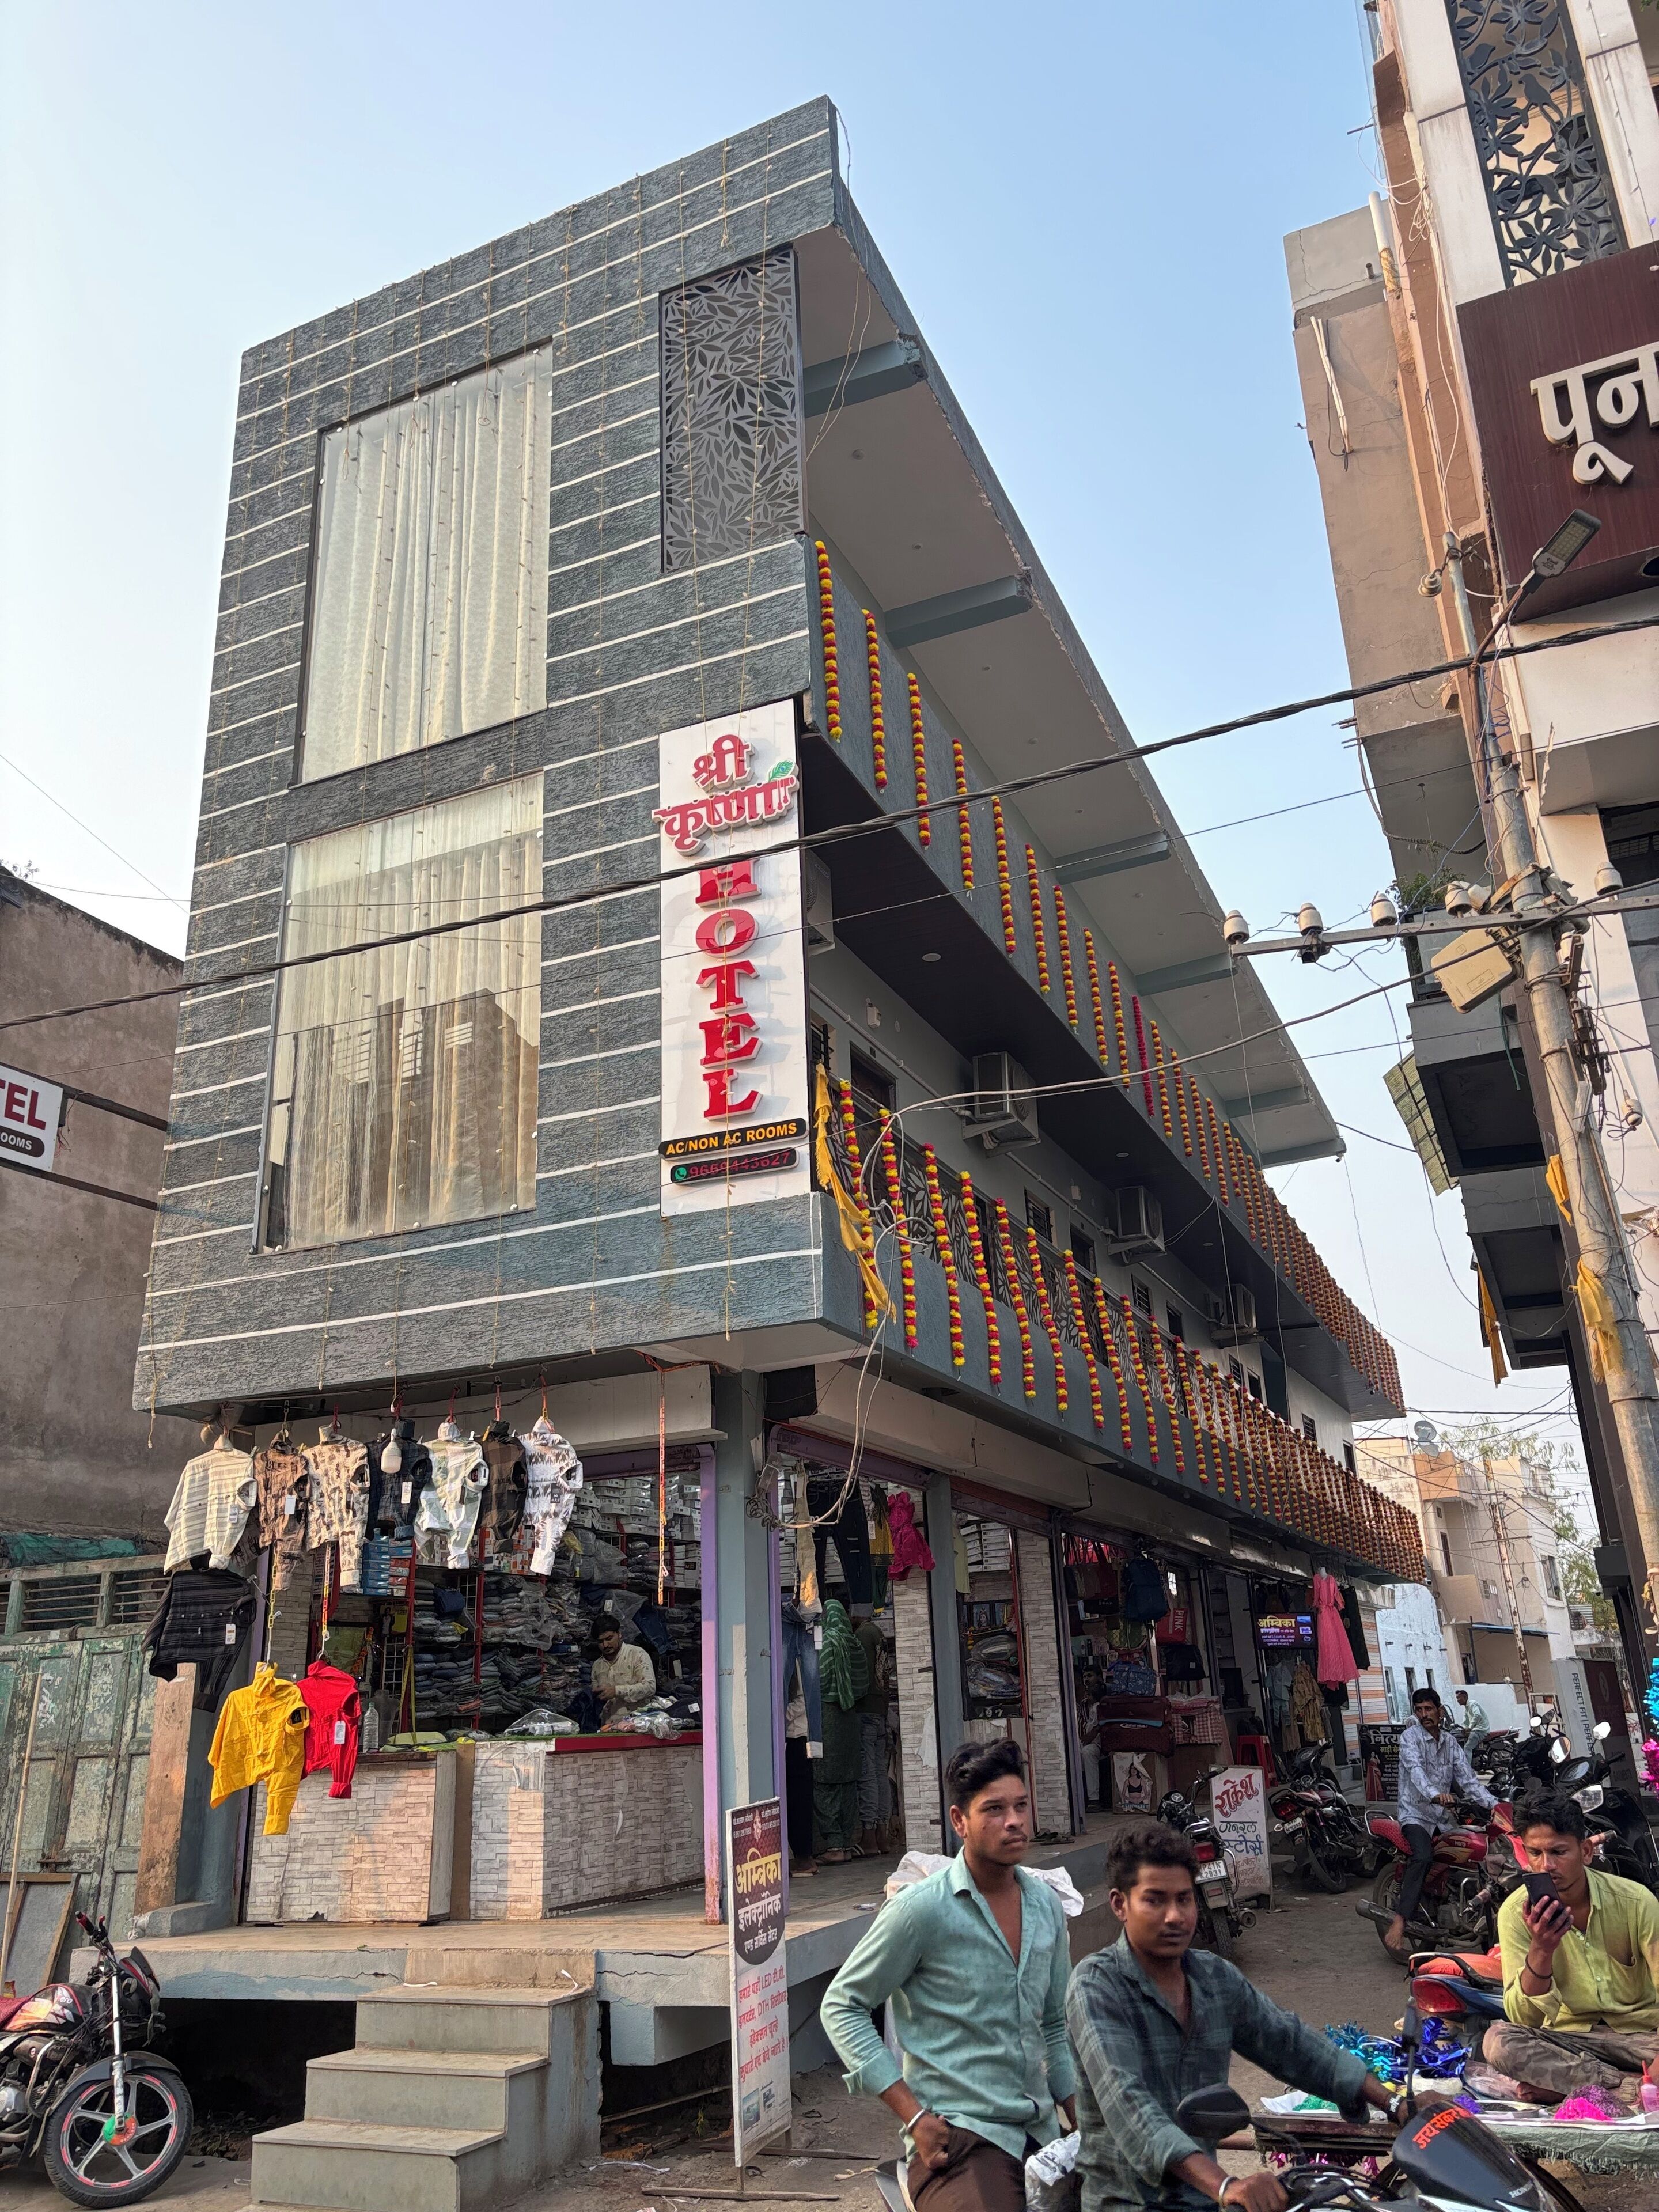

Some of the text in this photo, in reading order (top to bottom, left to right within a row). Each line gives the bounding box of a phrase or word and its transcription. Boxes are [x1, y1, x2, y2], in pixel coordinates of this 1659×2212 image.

[692, 734, 749, 786] श्री
[653, 776, 795, 850] कृष्णा
[695, 850, 762, 1120] HOTEL
[0, 1078, 46, 1130] EL
[0, 1131, 32, 1150] OOMS
[666, 1122, 797, 1156] AC/NON AC ROOMS
[1175, 1609, 1184, 1631] PINK
[1572, 1673, 1585, 1705] PERFECT
[1579, 1706, 1588, 1719] FIT
[1583, 1724, 1595, 1756] PERFEC
[1215, 1772, 1259, 1818] राकेश
[1219, 1821, 1258, 1834] जनरल
[735, 1847, 781, 1894] अम्बिका
[738, 1891, 781, 1932] इलेक्ट्रॉनिक
[754, 1929, 767, 1949] सर्विस
[739, 1980, 751, 2003] हमारे
[762, 1972, 772, 1990] LED
[758, 1997, 769, 2016] DTH
[771, 2038, 781, 2056] जाते
[1412, 2122, 1440, 2149] जय
